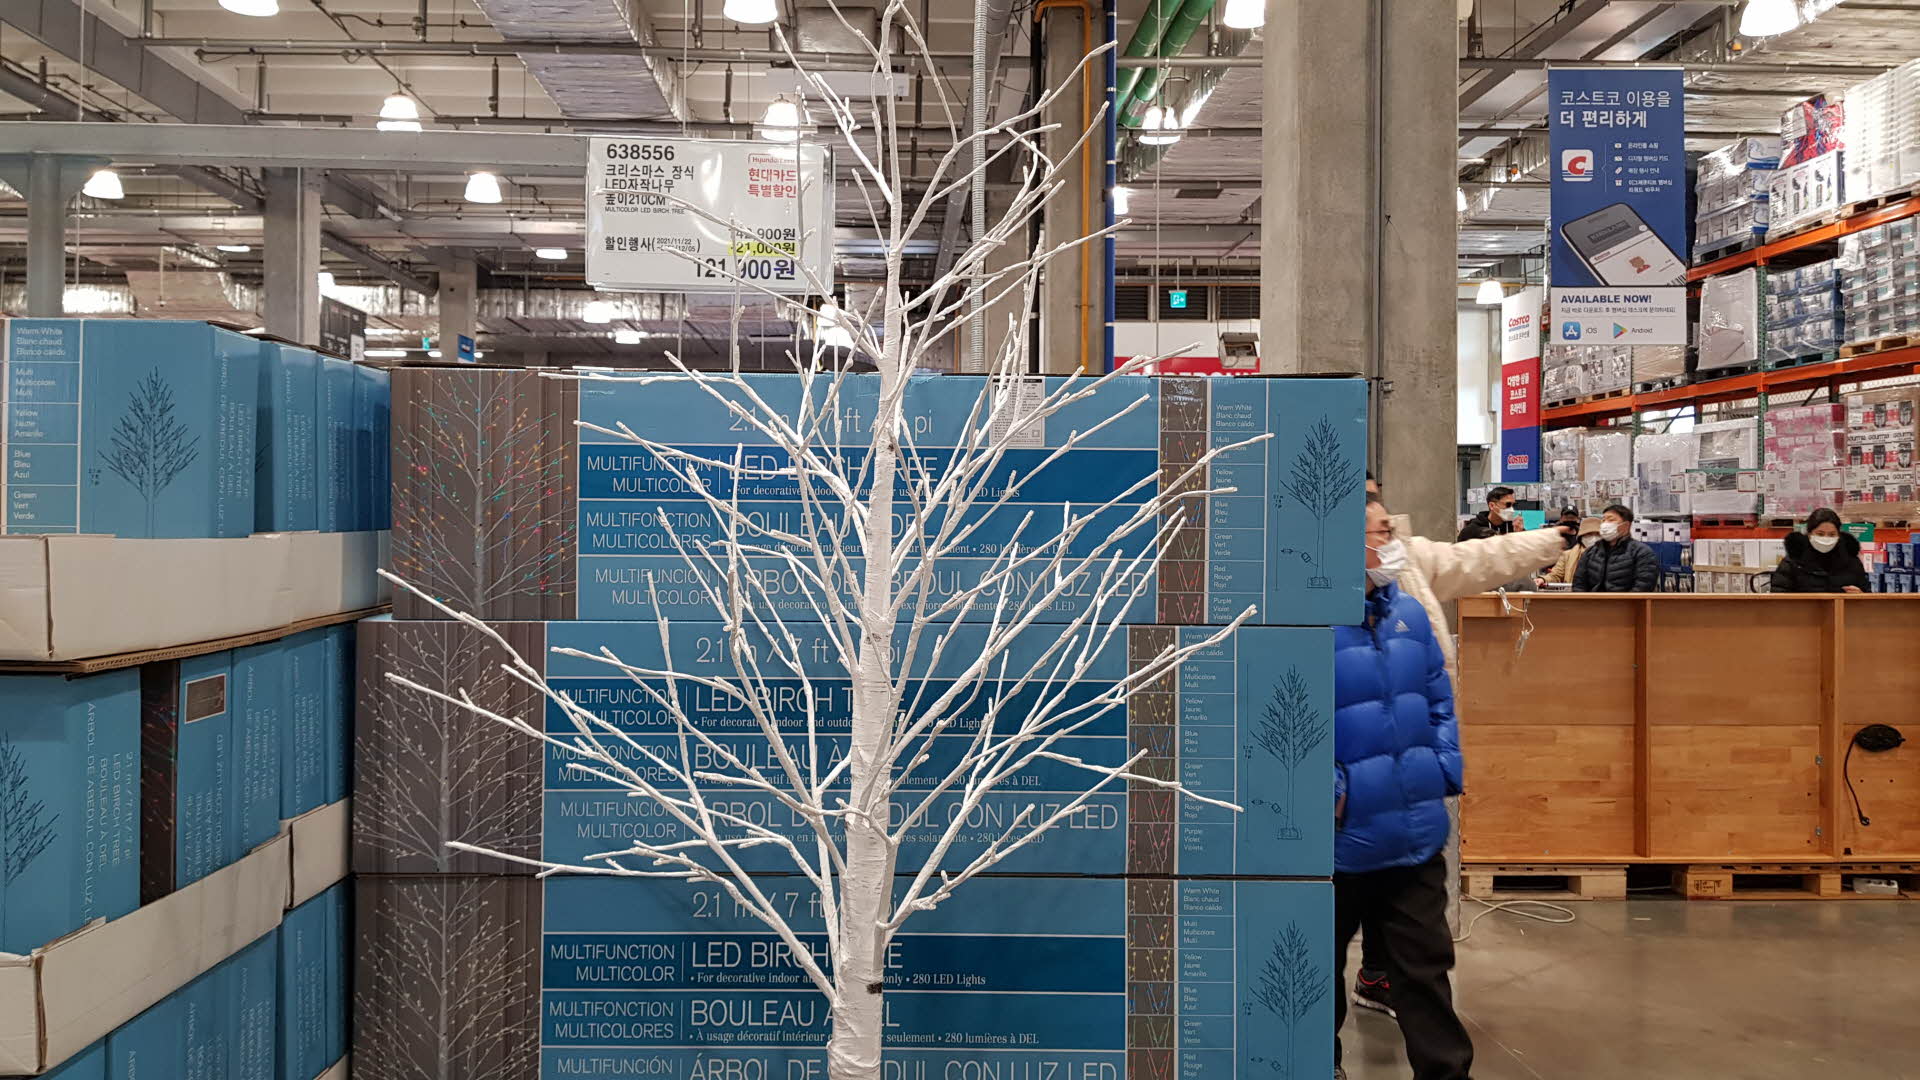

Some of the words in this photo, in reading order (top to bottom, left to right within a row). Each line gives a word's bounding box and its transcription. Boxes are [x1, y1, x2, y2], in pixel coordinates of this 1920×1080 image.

[1560, 91, 1620, 106] 코스트코
[1627, 90, 1671, 107] 이용을
[1560, 111, 1574, 128] 더
[1582, 110, 1647, 128] 편리하게
[607, 144, 675, 161] 638556
[605, 164, 664, 178] 크리스마스
[671, 165, 694, 180] 장식
[748, 168, 796, 182] 현대카드
[604, 178, 675, 193] LED자작나무
[747, 184, 796, 198] 특별할인
[1561, 295, 1620, 303] AVAILABLE
[1624, 294, 1652, 303] NOW!
[1508, 315, 1530, 328] COSTCO
[15, 409, 38, 418] Yellow
[844, 407, 860, 433] ft
[914, 409, 932, 441] pi
[14, 450, 31, 458] Blue
[1508, 455, 1528, 465] COSTCO
[729, 455, 777, 480] LED
[13, 491, 37, 499] Green
[753, 484, 800, 495] decorative
[13, 512, 35, 520] Verde
[586, 512, 711, 527] MULTIFONCTION
[592, 534, 711, 548] MULTICOLORES
[979, 543, 997, 554] 280
[1213, 573, 1232, 581] Rouge
[1055, 602, 1075, 611] LED
[696, 637, 724, 663] 2.1
[812, 638, 829, 663] ft
[695, 687, 744, 712] LED
[701, 717, 717, 727] For
[87, 756, 95, 775] DE
[113, 753, 121, 781] LED
[1021, 776, 1041, 786] DEL
[99, 758, 108, 826] BOULEAU
[85, 780, 95, 838] ABEDUL
[112, 784, 121, 827] BIRCH
[1184, 803, 1203, 811] Rouge
[1070, 804, 1118, 829] LED
[577, 823, 677, 838] MULTICOLOR
[977, 833, 995, 842] 280
[112, 830, 120, 865] TREE
[84, 843, 94, 873] CON
[99, 844, 108, 872] DEL
[693, 892, 720, 918] 2.1
[784, 892, 799, 918] 7
[551, 944, 675, 960] MULTIFUNCTION
[692, 942, 740, 968] LED
[751, 942, 829, 968] BIRCH
[576, 966, 675, 981] MULTICOLOR
[697, 973, 713, 983] For
[716, 973, 766, 983] decorative
[768, 973, 800, 983] indoor
[883, 974, 903, 985] only
[912, 975, 931, 985] 280
[933, 975, 954, 985] LED
[956, 975, 986, 987] Lights
[550, 1001, 674, 1017] MULTIFONCTION
[691, 1000, 814, 1026] BOULEAU
[555, 1023, 674, 1039] MULTICOLORES
[696, 1030, 704, 1041] À
[706, 1032, 734, 1044] usage
[735, 1030, 781, 1041] décoratif
[782, 1030, 825, 1042] intérieur
[886, 1033, 935, 1043] seulement
[945, 1033, 963, 1044] 280
[965, 1033, 1007, 1044] lumières
[1010, 1033, 1017, 1044] à
[1019, 1034, 1039, 1044] DEL
[557, 1056, 673, 1073] MULTIFUNCIÓN
[690, 1053, 768, 1080] ÁRBOL
[945, 1061, 1000, 1080] CON
